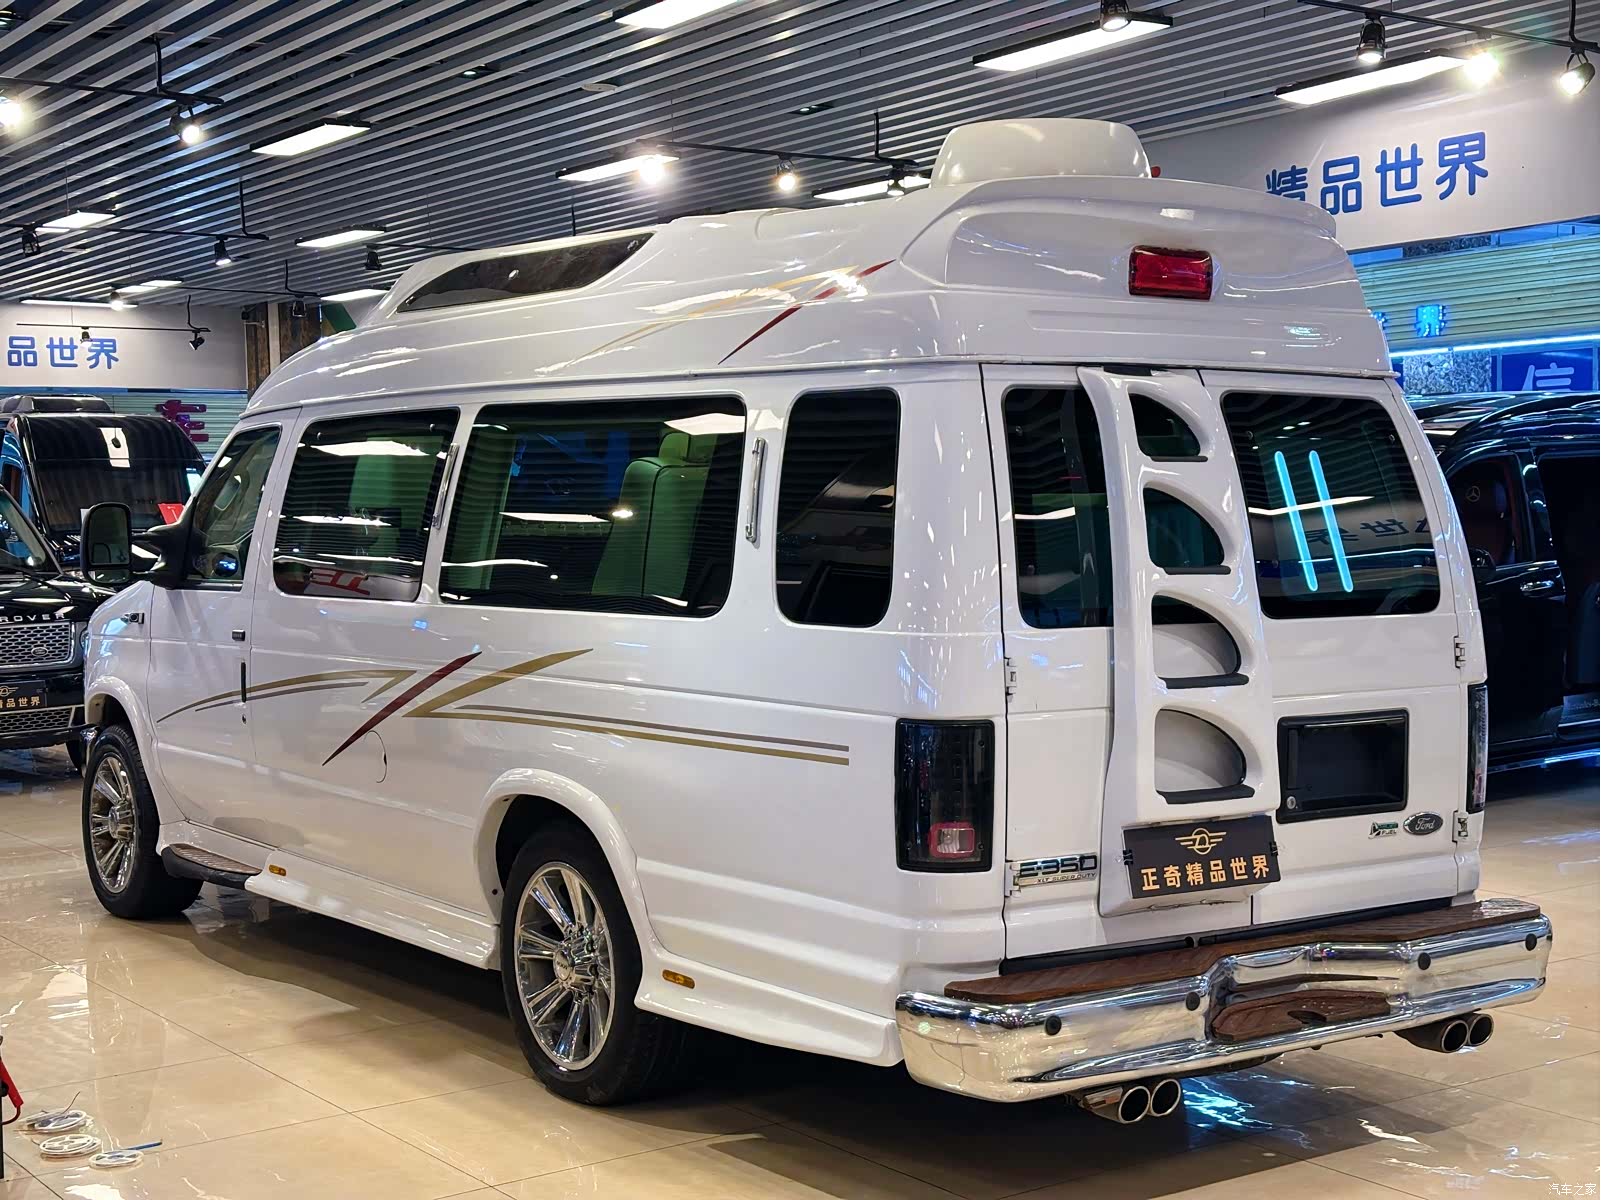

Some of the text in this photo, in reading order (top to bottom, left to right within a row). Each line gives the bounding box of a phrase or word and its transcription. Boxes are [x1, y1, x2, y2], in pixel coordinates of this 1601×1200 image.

[1265, 131, 1489, 216] 精品世界
[7, 336, 119, 369] 品世界
[1415, 817, 1436, 831] Ford
[1141, 854, 1270, 891] 正奇精品世界
